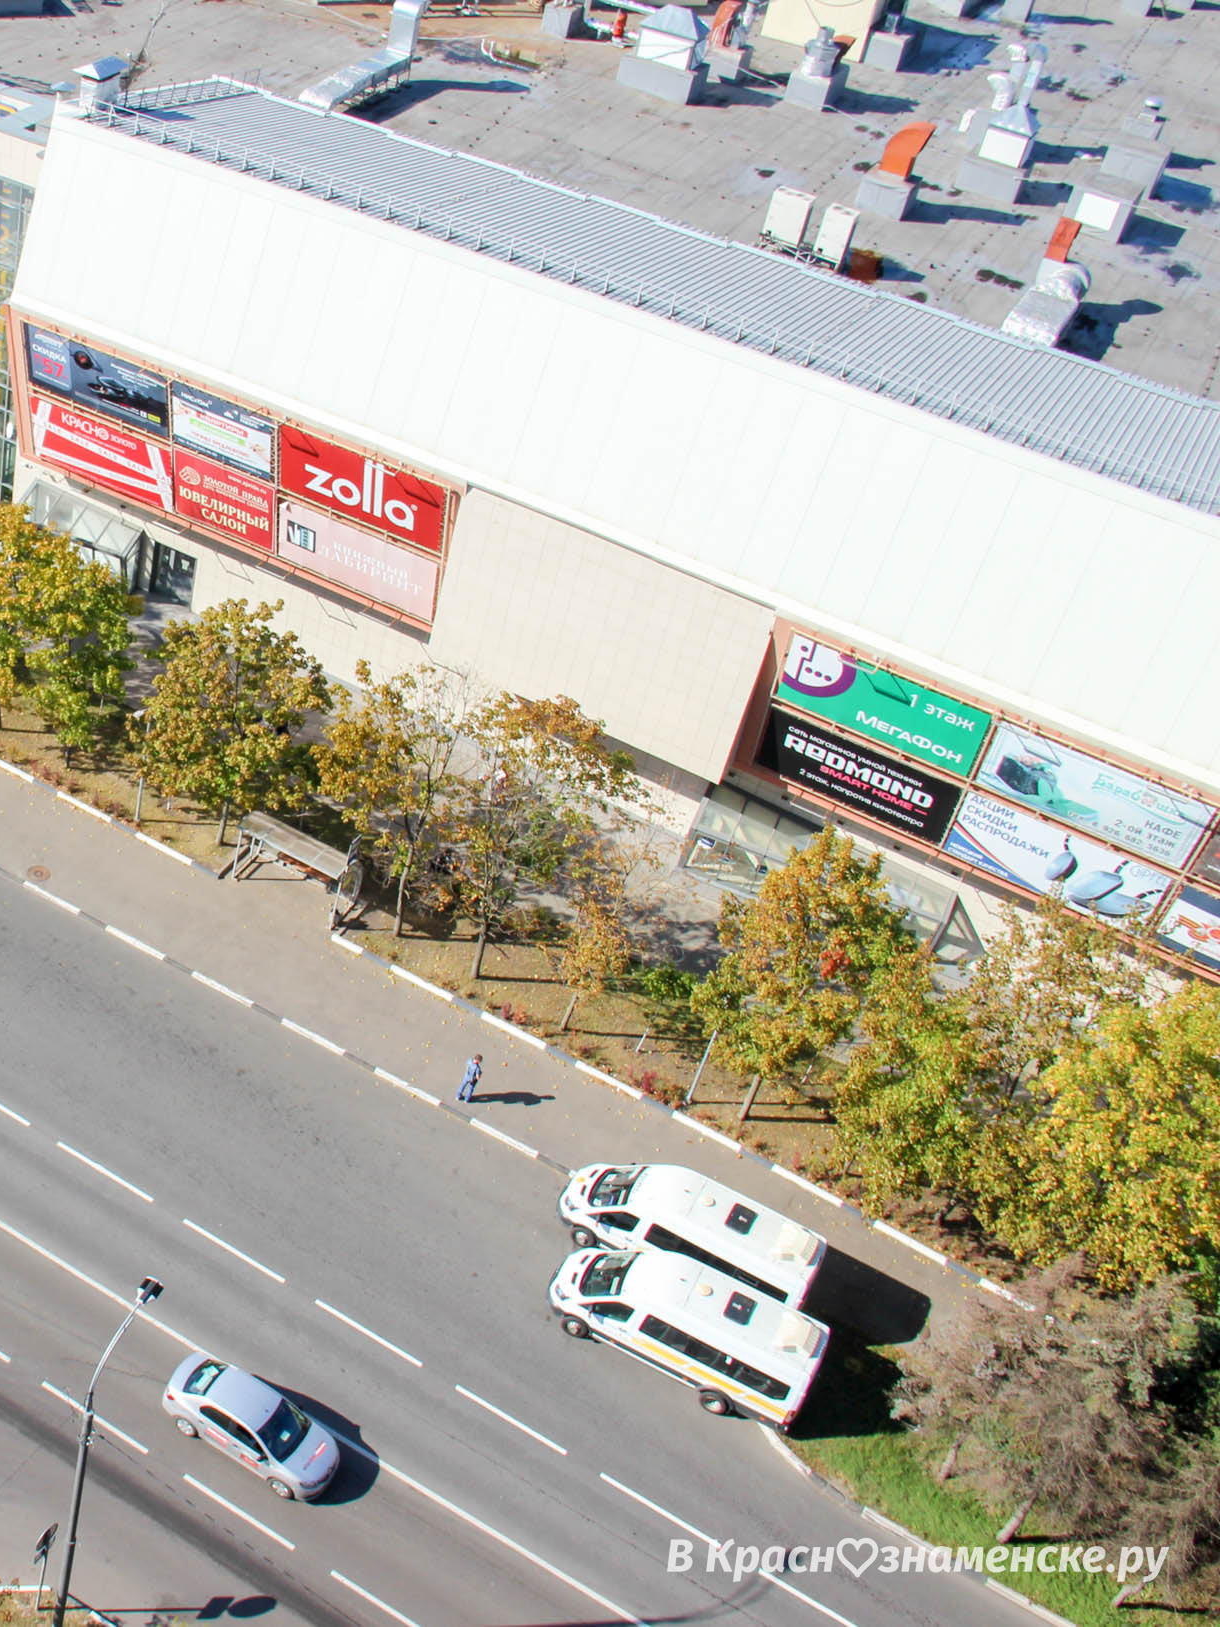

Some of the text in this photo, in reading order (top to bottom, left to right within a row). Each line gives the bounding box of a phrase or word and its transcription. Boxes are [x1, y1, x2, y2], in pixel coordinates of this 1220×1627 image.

[32, 343, 67, 363] СКИДКА
[203, 475, 238, 495] ЗОЛОТОЙ
[304, 458, 415, 532] zolla
[179, 485, 269, 531] ЮВЕЛИРНЫЙ
[201, 508, 247, 535] САЛОН
[910, 694, 976, 732] 1 этаж
[788, 725, 923, 788] сеть магазинов умной техники
[799, 768, 806, 776] 2
[831, 783, 872, 806] напротив
[872, 800, 925, 829] кинотеатра
[819, 765, 914, 812] SMART HOME
[971, 795, 1015, 819] АКЦИИ
[962, 814, 1050, 858] РАСПРОДАЖИ
[966, 804, 1018, 833] СКИДКИ
[1145, 819, 1182, 841] КАФЕ
